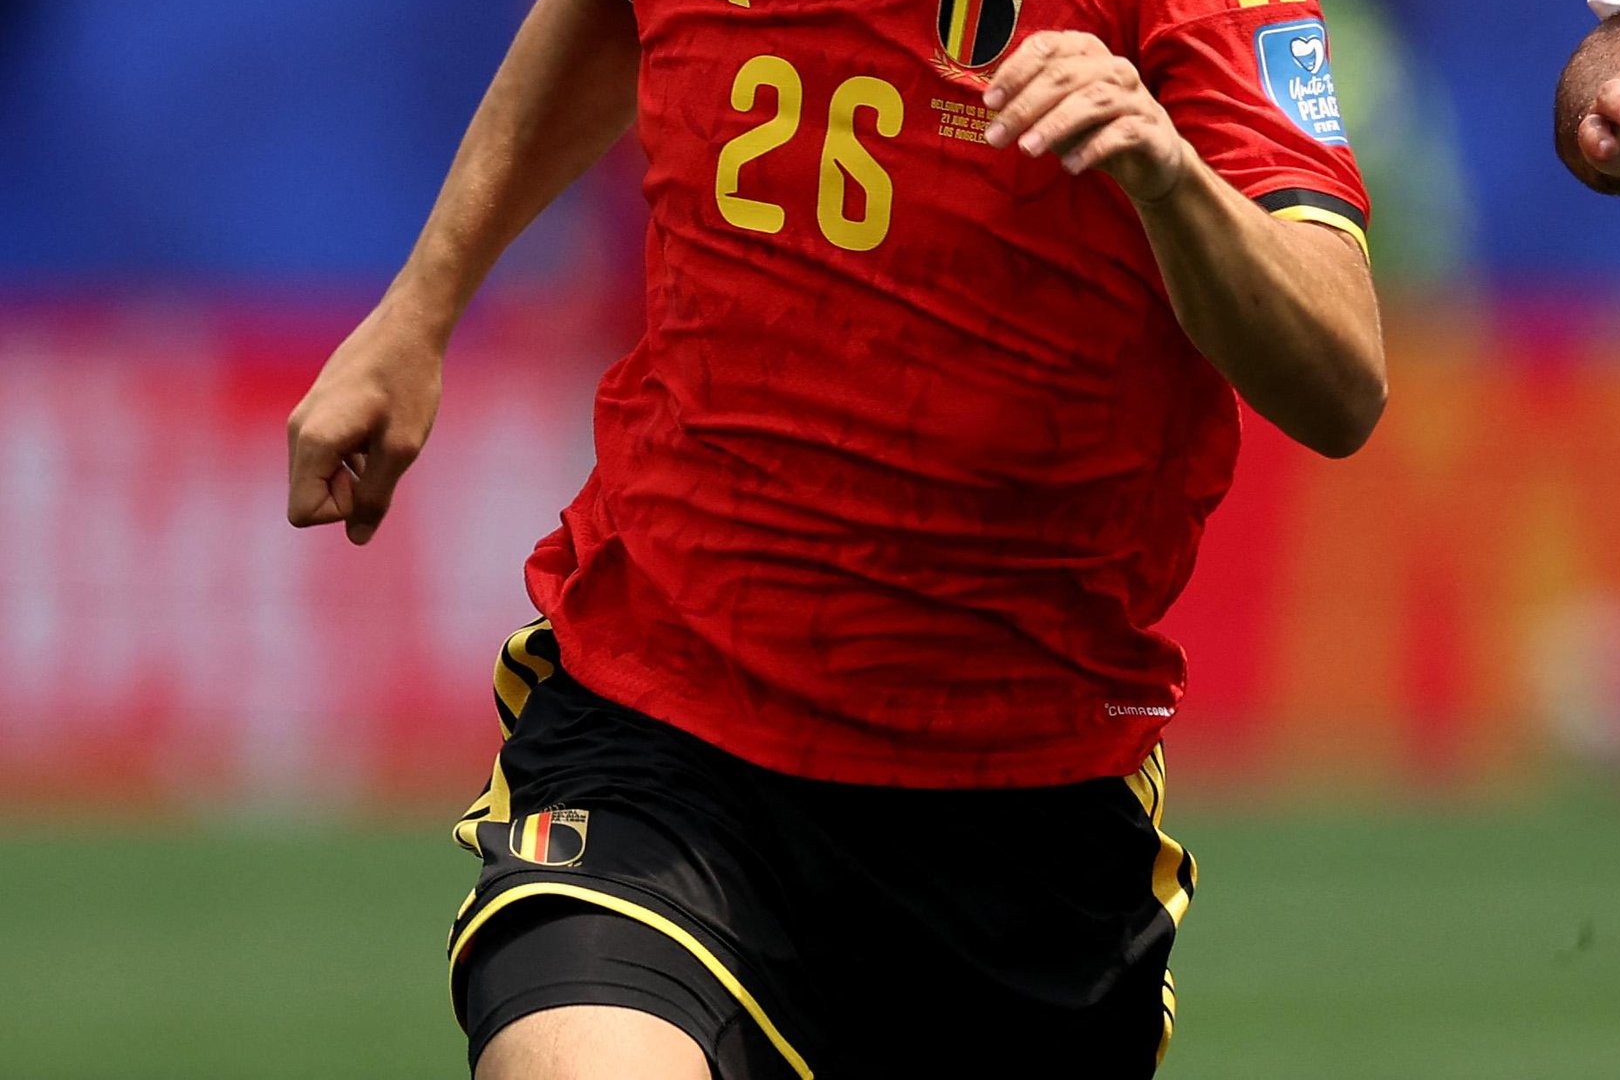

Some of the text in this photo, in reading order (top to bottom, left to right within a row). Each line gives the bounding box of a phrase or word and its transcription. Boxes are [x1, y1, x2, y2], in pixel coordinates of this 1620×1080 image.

[1297, 96, 1340, 121] PEAC
[941, 113, 951, 124] 21
[951, 115, 970, 128] JUNE
[1313, 120, 1341, 133] FIFA
[938, 125, 988, 145] LOS ANGELE
[715, 54, 904, 252] 26
